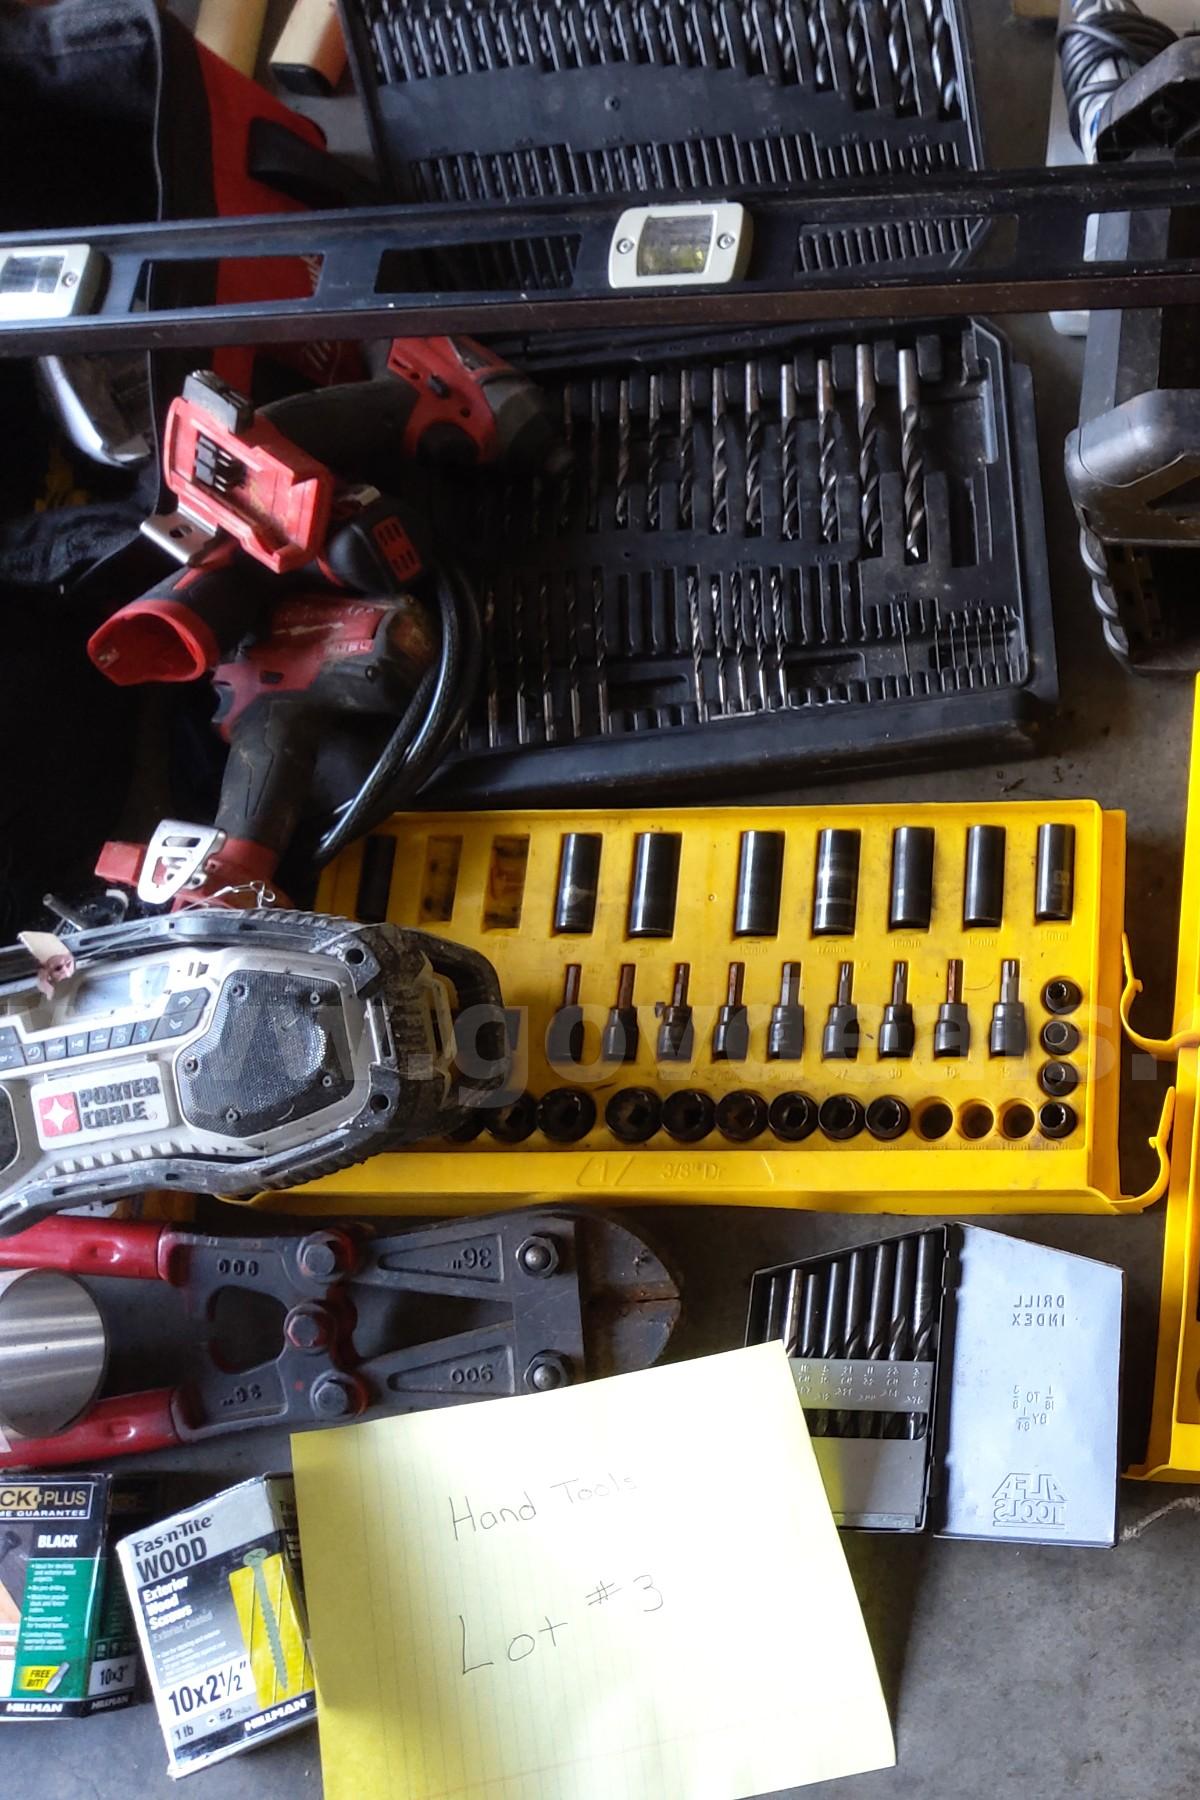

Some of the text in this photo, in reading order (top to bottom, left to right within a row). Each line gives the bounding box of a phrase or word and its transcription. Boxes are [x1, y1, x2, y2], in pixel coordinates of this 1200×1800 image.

[79, 1077, 160, 1107] PORTER
[83, 1101, 150, 1129] CABLE
[452, 1246, 491, 1271] 36"
[16, 1509, 86, 1517] GUARANTEE
[448, 1472, 638, 1541] Hand Tools
[37, 1534, 79, 1549] BLACK
[136, 1536, 208, 1583] WOOD
[143, 1574, 189, 1604] Exterior
[459, 1614, 568, 1675] Lot
[30, 1669, 52, 1679] FREE
[6, 1702, 63, 1713] HILLMAN
[243, 1697, 308, 1732] HILLMAN
